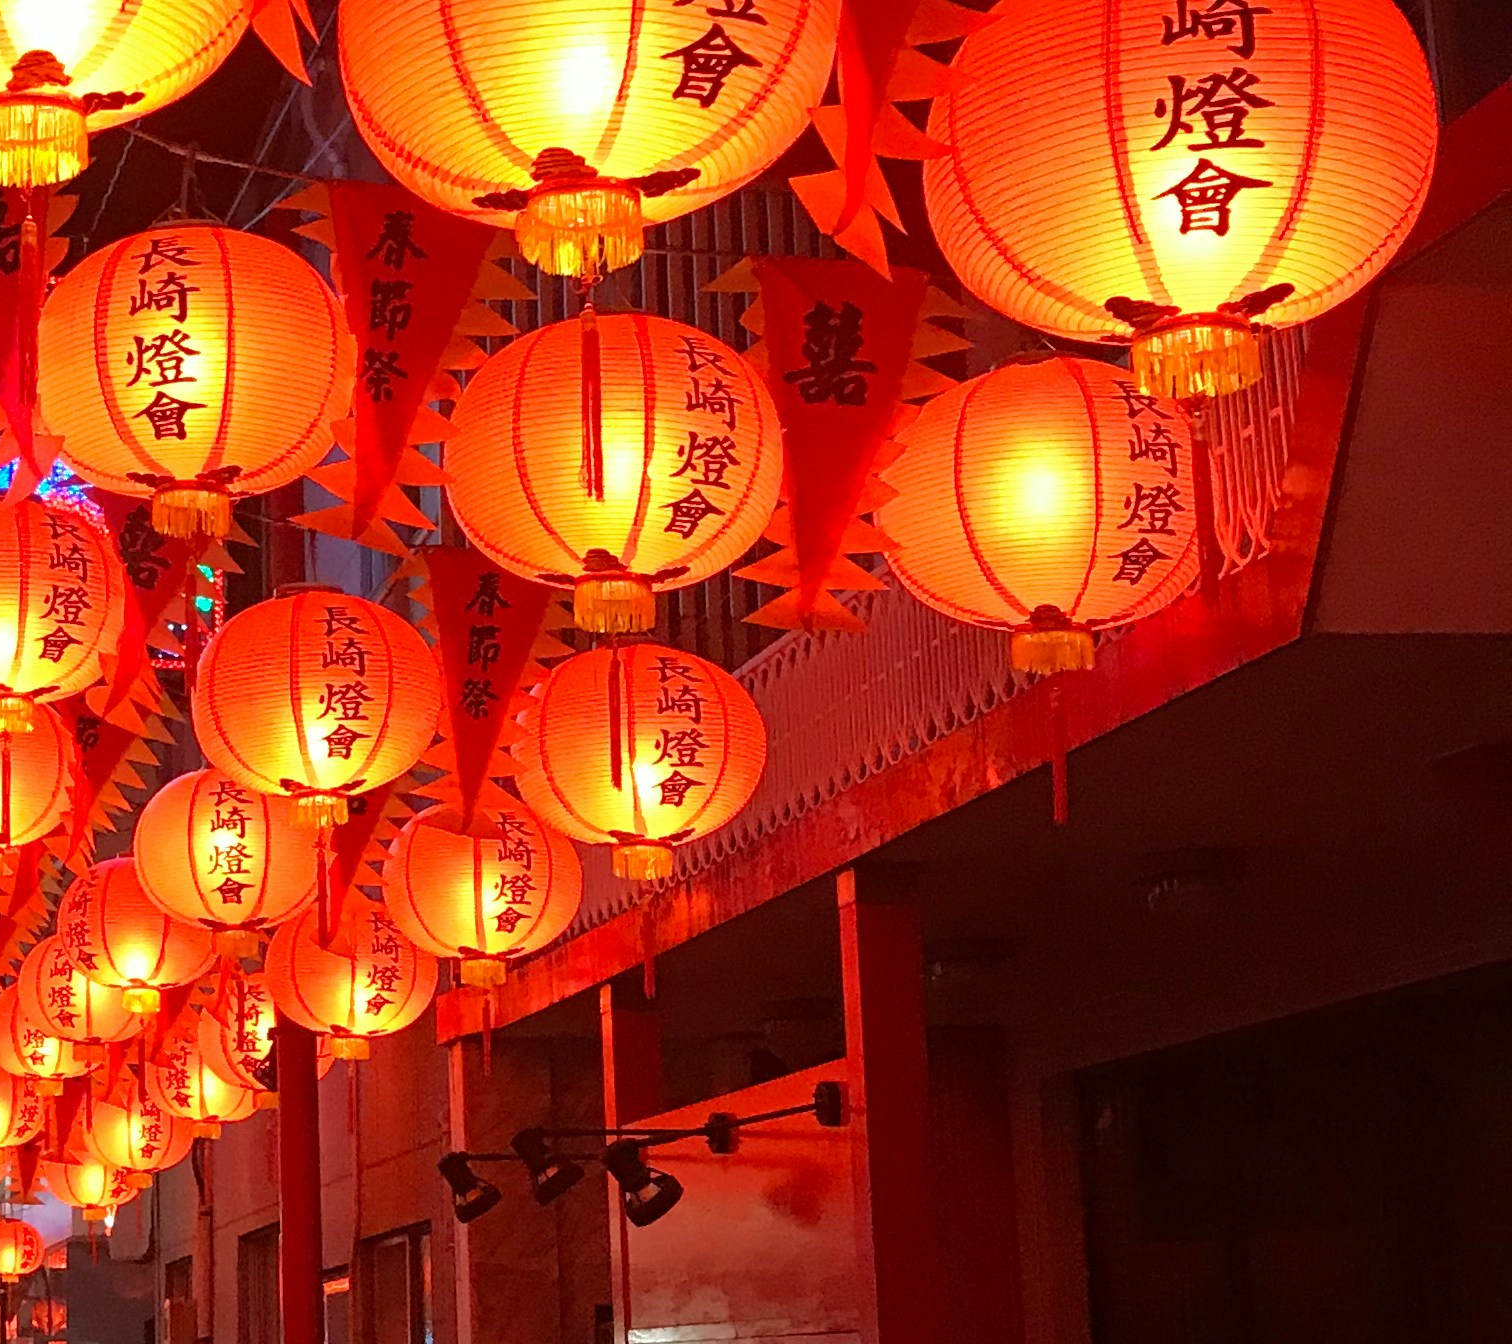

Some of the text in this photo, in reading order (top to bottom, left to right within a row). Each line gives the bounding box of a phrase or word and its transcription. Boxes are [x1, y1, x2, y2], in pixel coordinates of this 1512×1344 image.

[125, 235, 208, 442] 長崎燈會
[363, 209, 428, 404] 春節祭
[661, 335, 745, 541] 長崎燈會
[1106, 379, 1187, 587] 長崎燈會
[37, 512, 93, 664] 長崎燈會
[460, 572, 512, 721] 春節祭
[316, 606, 376, 762] 長崎燈會
[647, 657, 710, 808] 長崎燈會
[206, 779, 255, 905] 長崎燈會
[493, 811, 538, 935] 長崎燈會
[365, 910, 403, 1018] 長崎燈會
